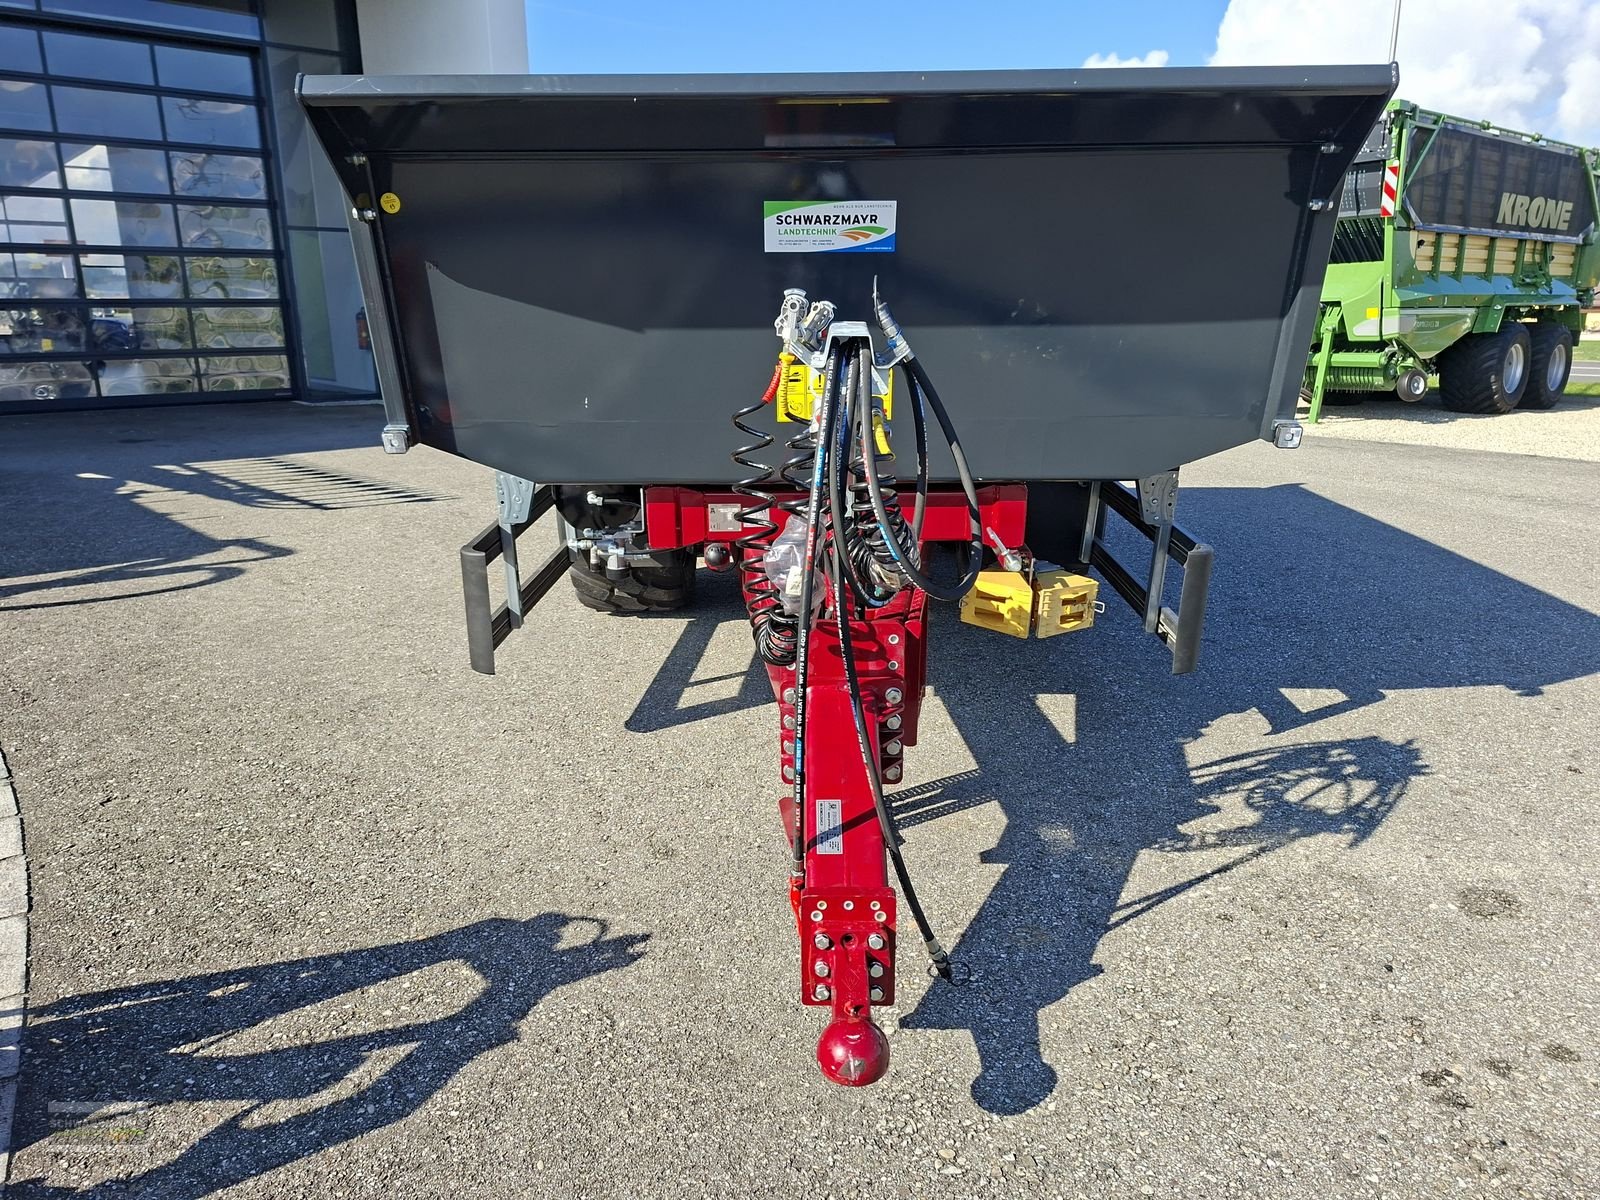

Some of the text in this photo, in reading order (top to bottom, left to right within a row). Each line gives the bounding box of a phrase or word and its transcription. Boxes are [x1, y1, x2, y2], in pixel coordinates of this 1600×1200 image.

[1496, 192, 1574, 230] KRONE
[776, 214, 878, 226] SCHWARZMAYR
[778, 228, 837, 236] LANDTECHNIK
